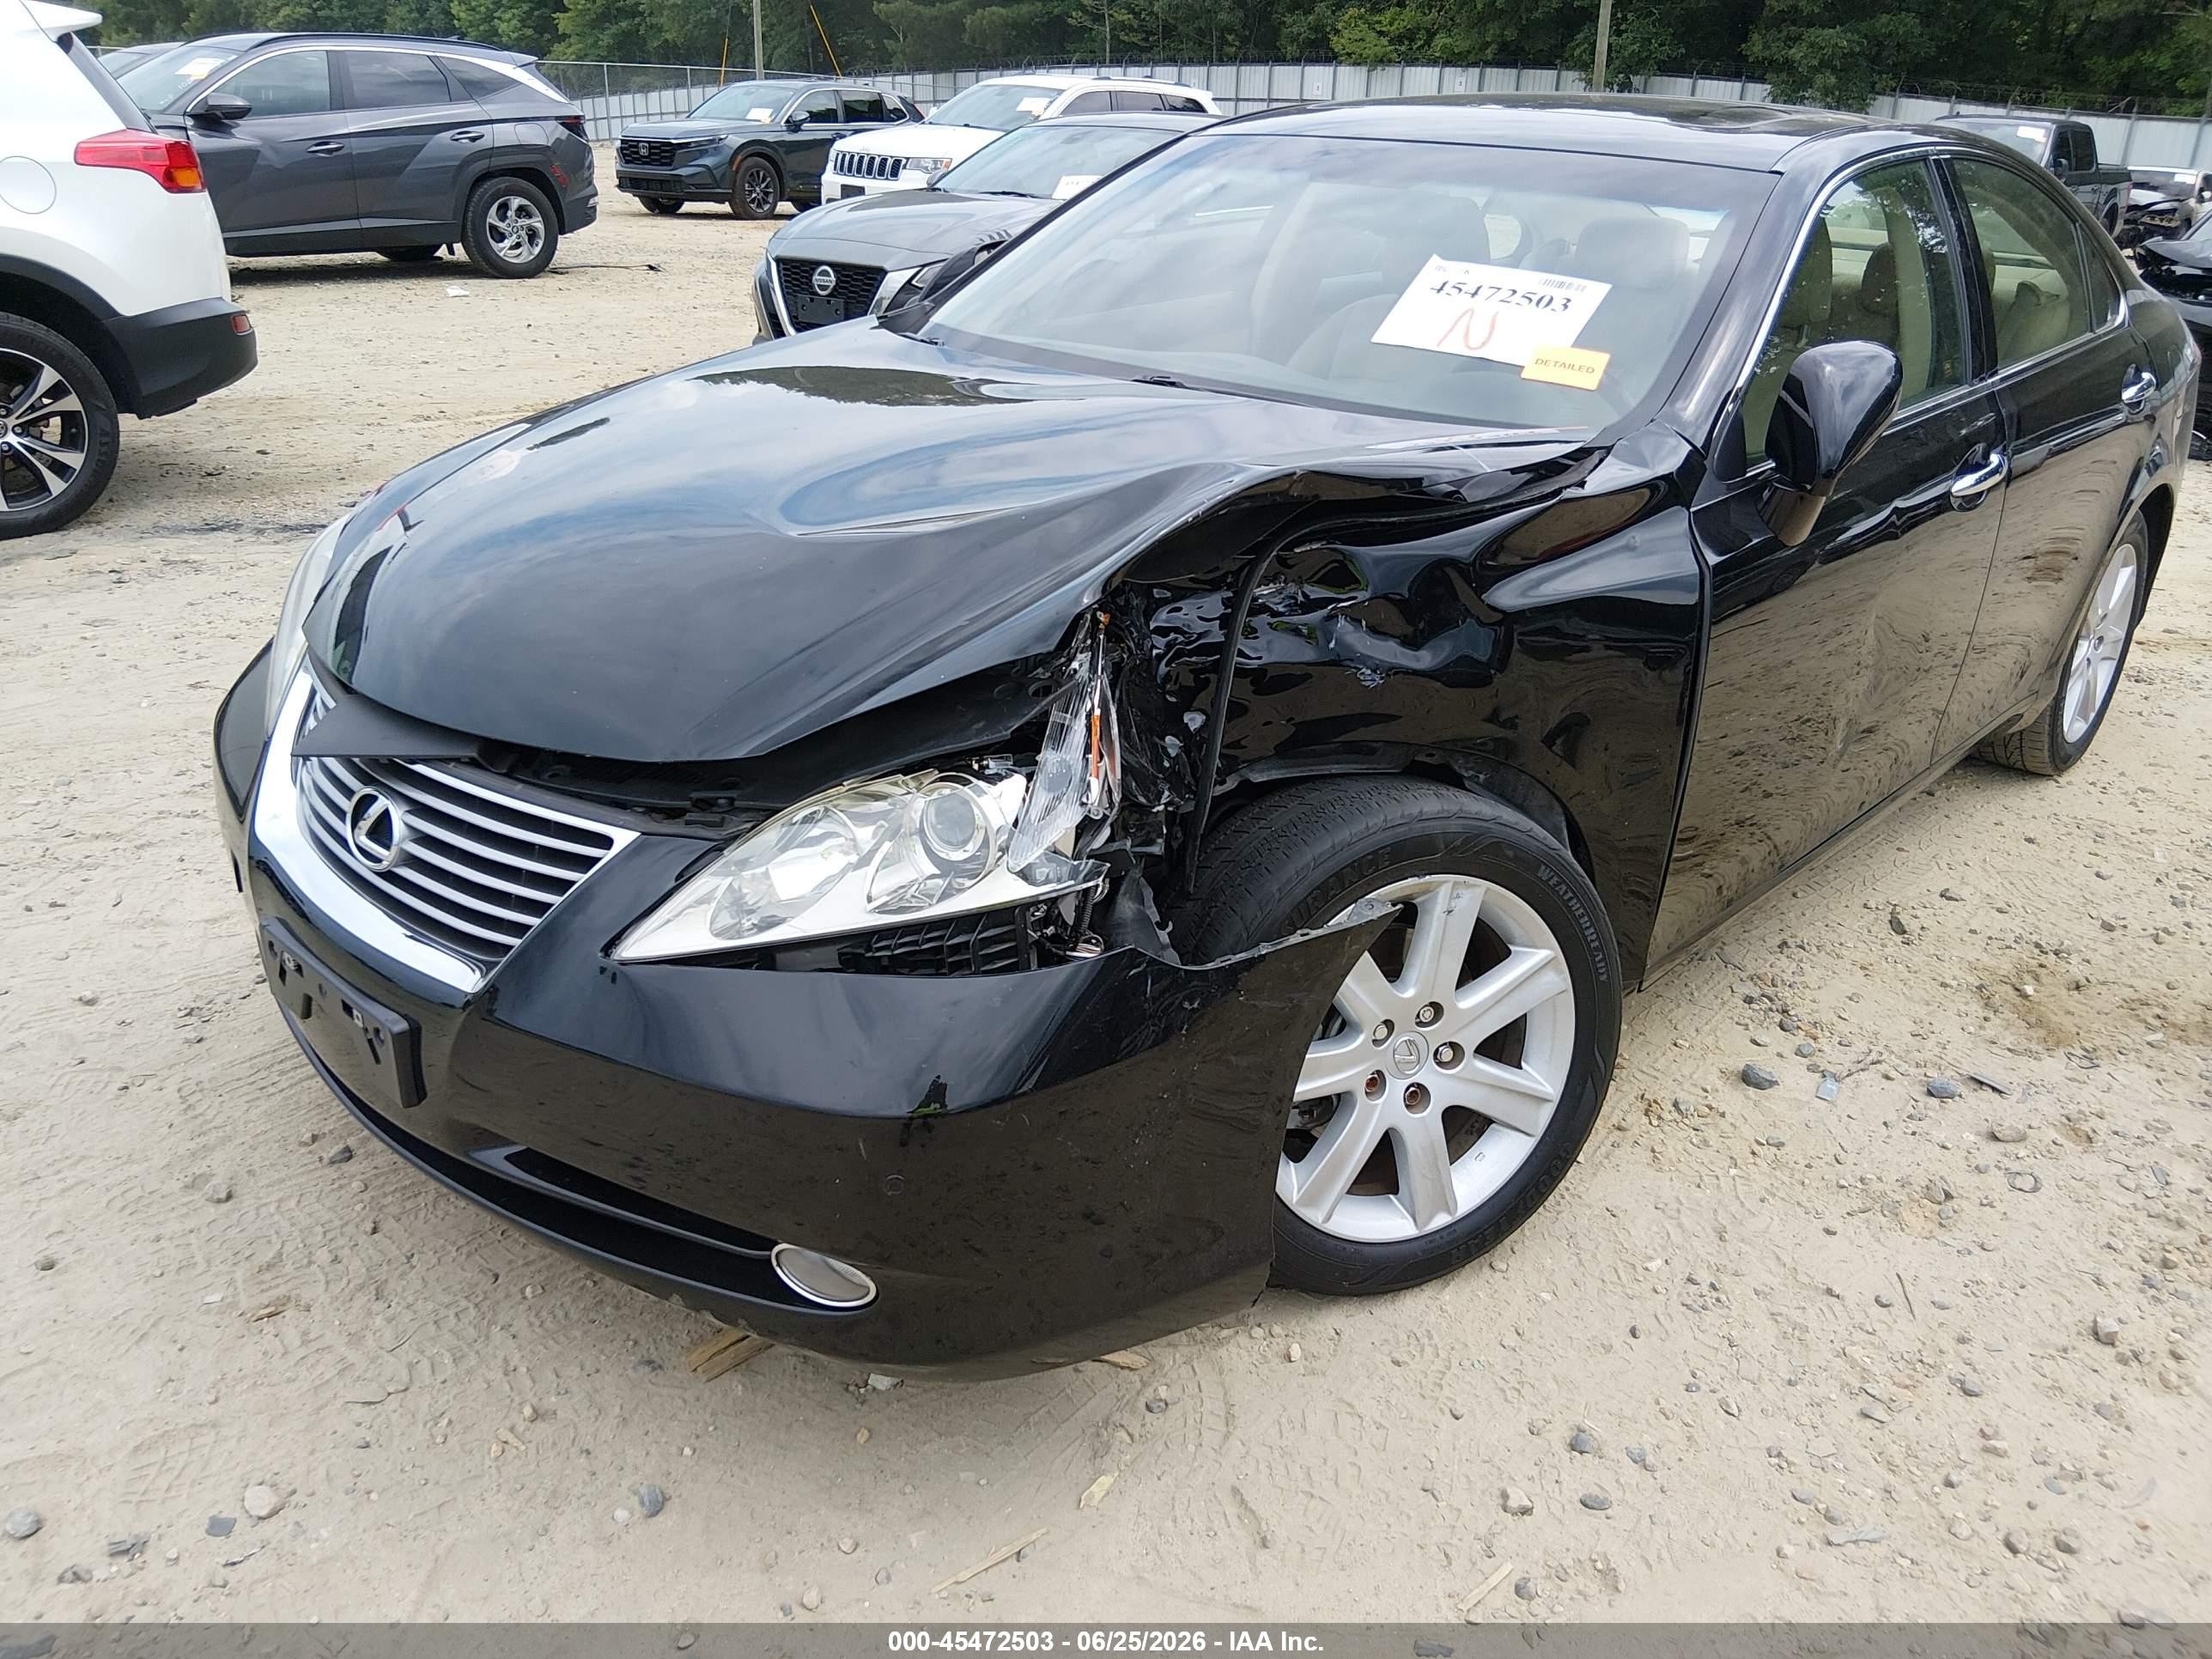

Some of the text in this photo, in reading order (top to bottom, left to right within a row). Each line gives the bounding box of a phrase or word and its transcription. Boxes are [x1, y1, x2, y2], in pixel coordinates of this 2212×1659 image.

[1430, 280, 1572, 313] 45472503
[1534, 358, 1595, 374] DETAILED
[1537, 864, 1608, 982] WEATHERREADY
